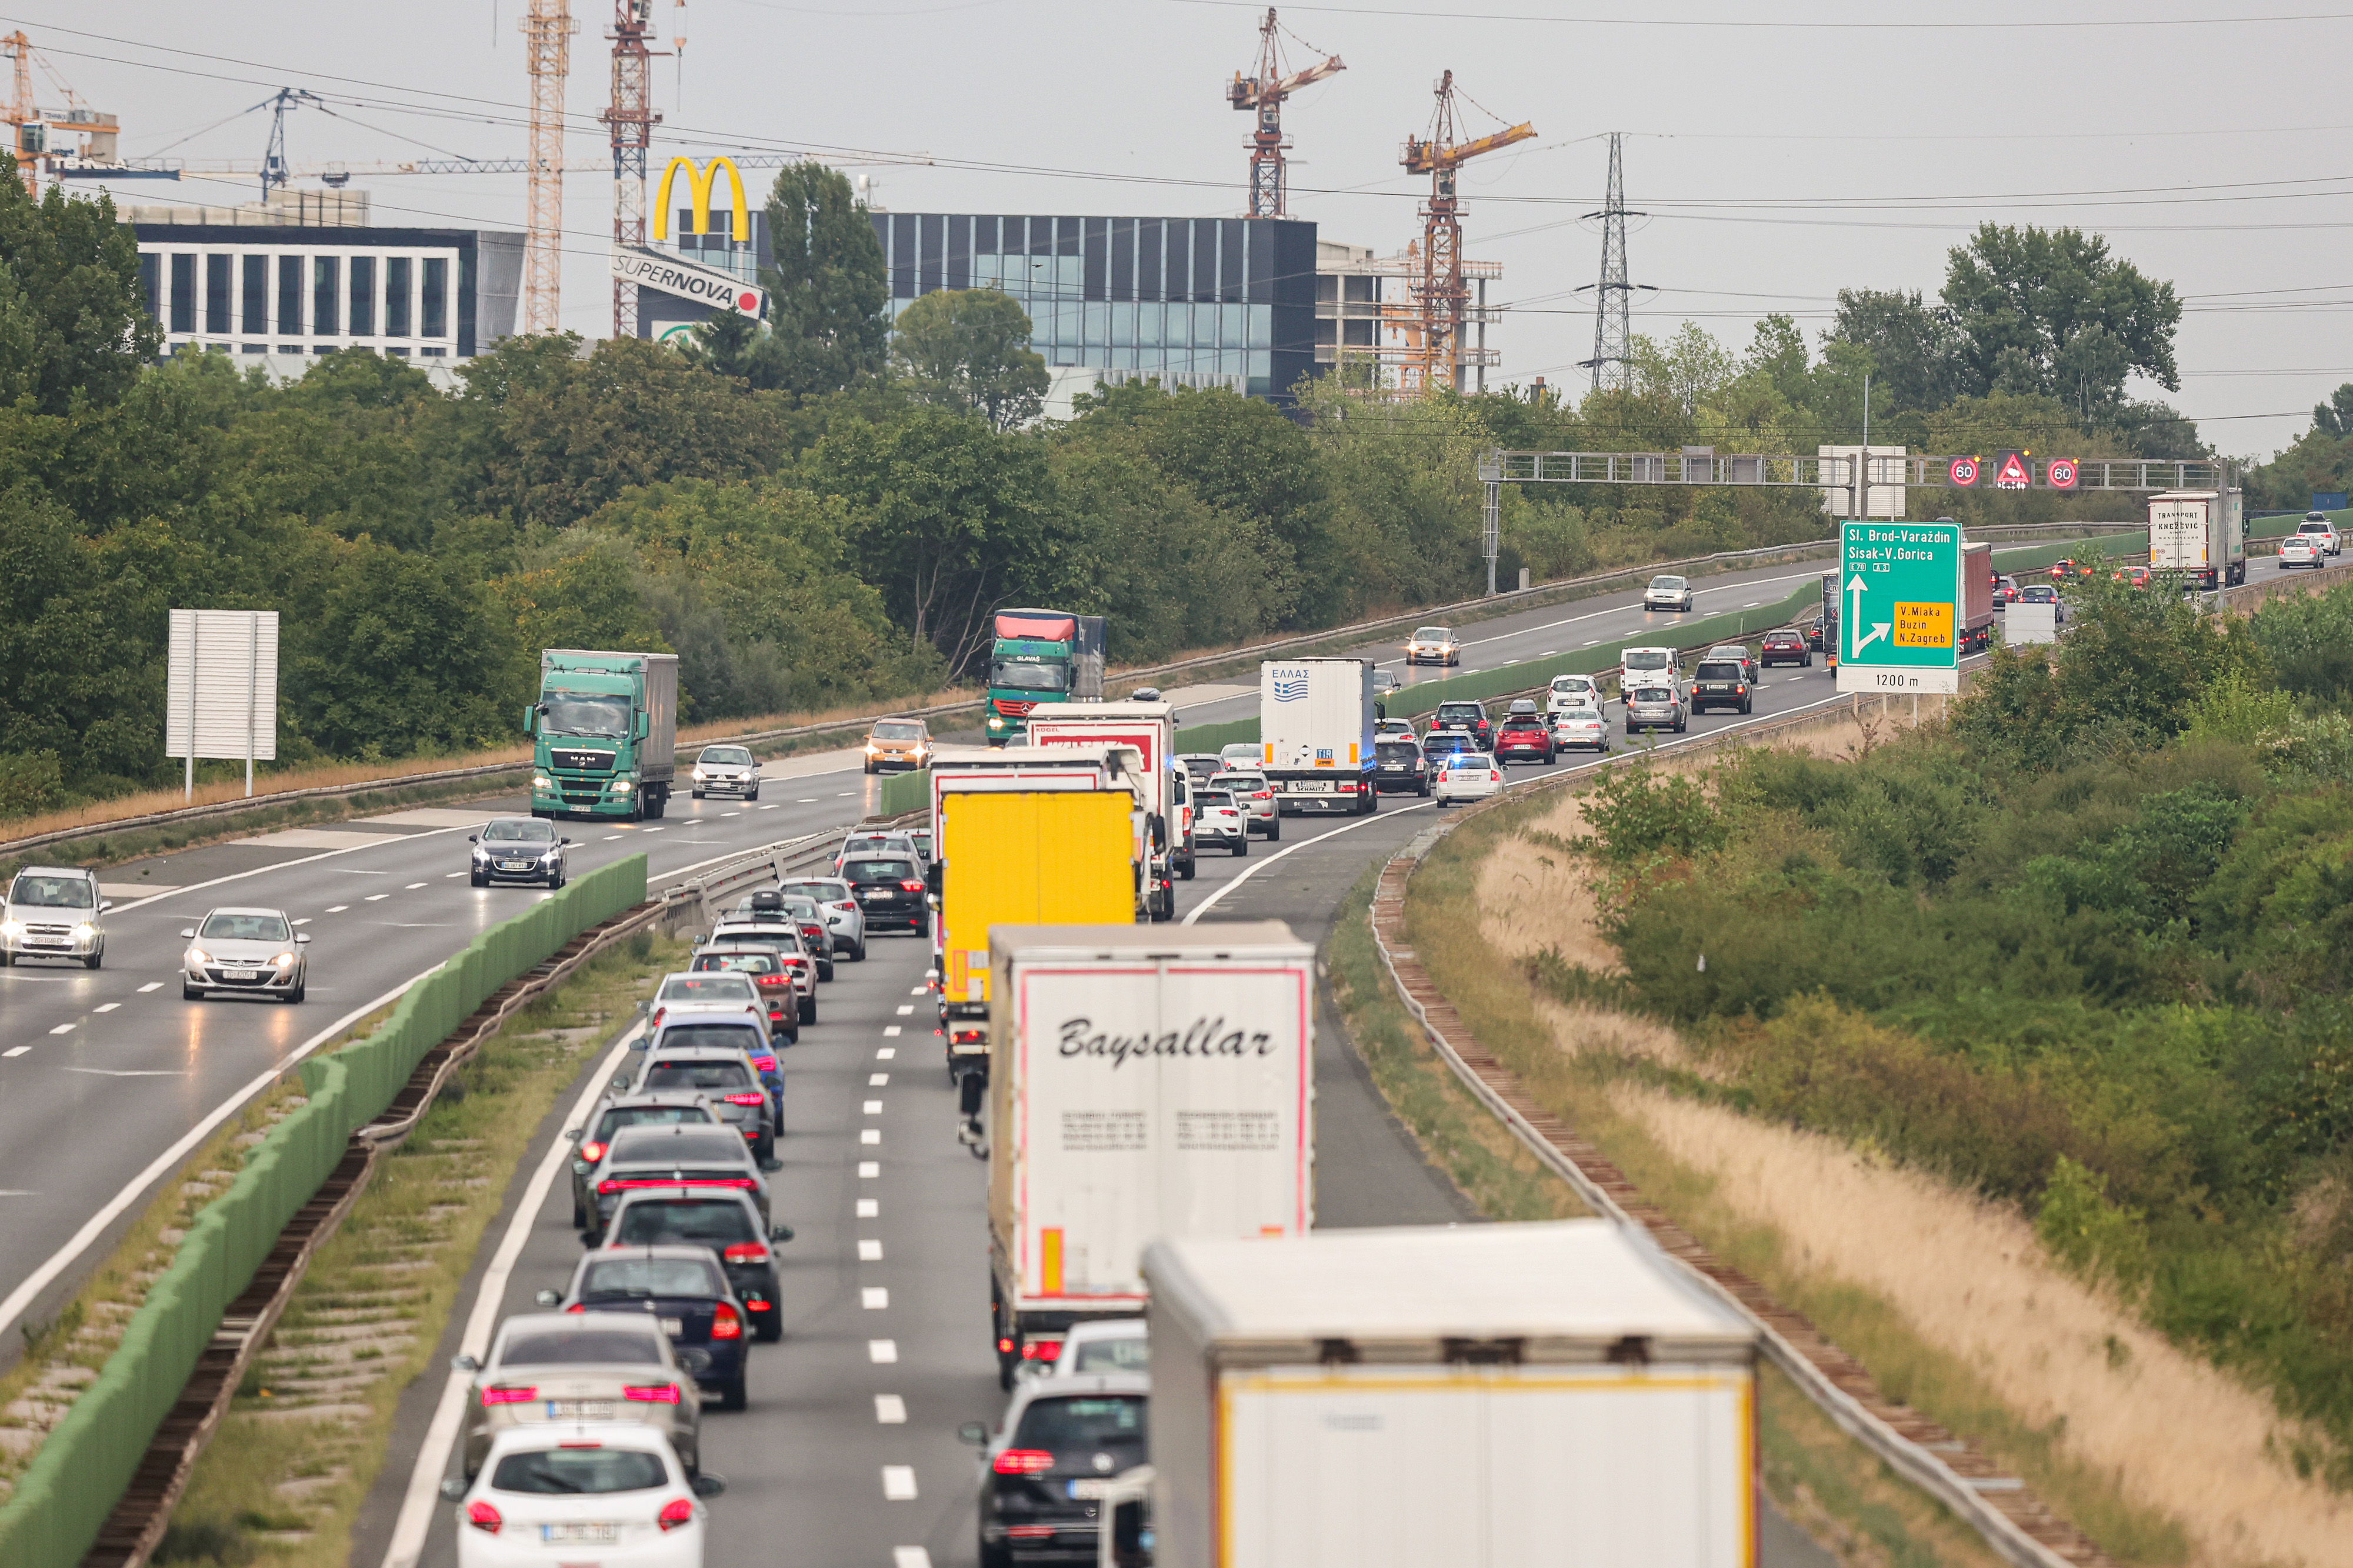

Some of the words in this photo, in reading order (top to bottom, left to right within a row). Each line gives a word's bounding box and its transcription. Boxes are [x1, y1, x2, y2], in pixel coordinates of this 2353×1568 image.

[614, 255, 733, 304] SUPERNOVA
[1956, 466, 1972, 478] 60
[2054, 468, 2071, 479] 60
[1849, 529, 1864, 541] Sl.
[1869, 529, 1950, 543] Brod-Varaždin
[1849, 547, 1933, 560] Sisak-V.Gorica
[1901, 606, 1940, 616] V.Mlaka
[1900, 619, 1927, 629] Buzin
[1899, 633, 1945, 645] N.Zagreb
[1272, 670, 1309, 678] ΕΛΛΑΣ
[1877, 674, 1904, 686] 1200
[1909, 678, 1918, 686] m
[1318, 749, 1332, 759] TIR
[1058, 1017, 1275, 1070] Baysallar
